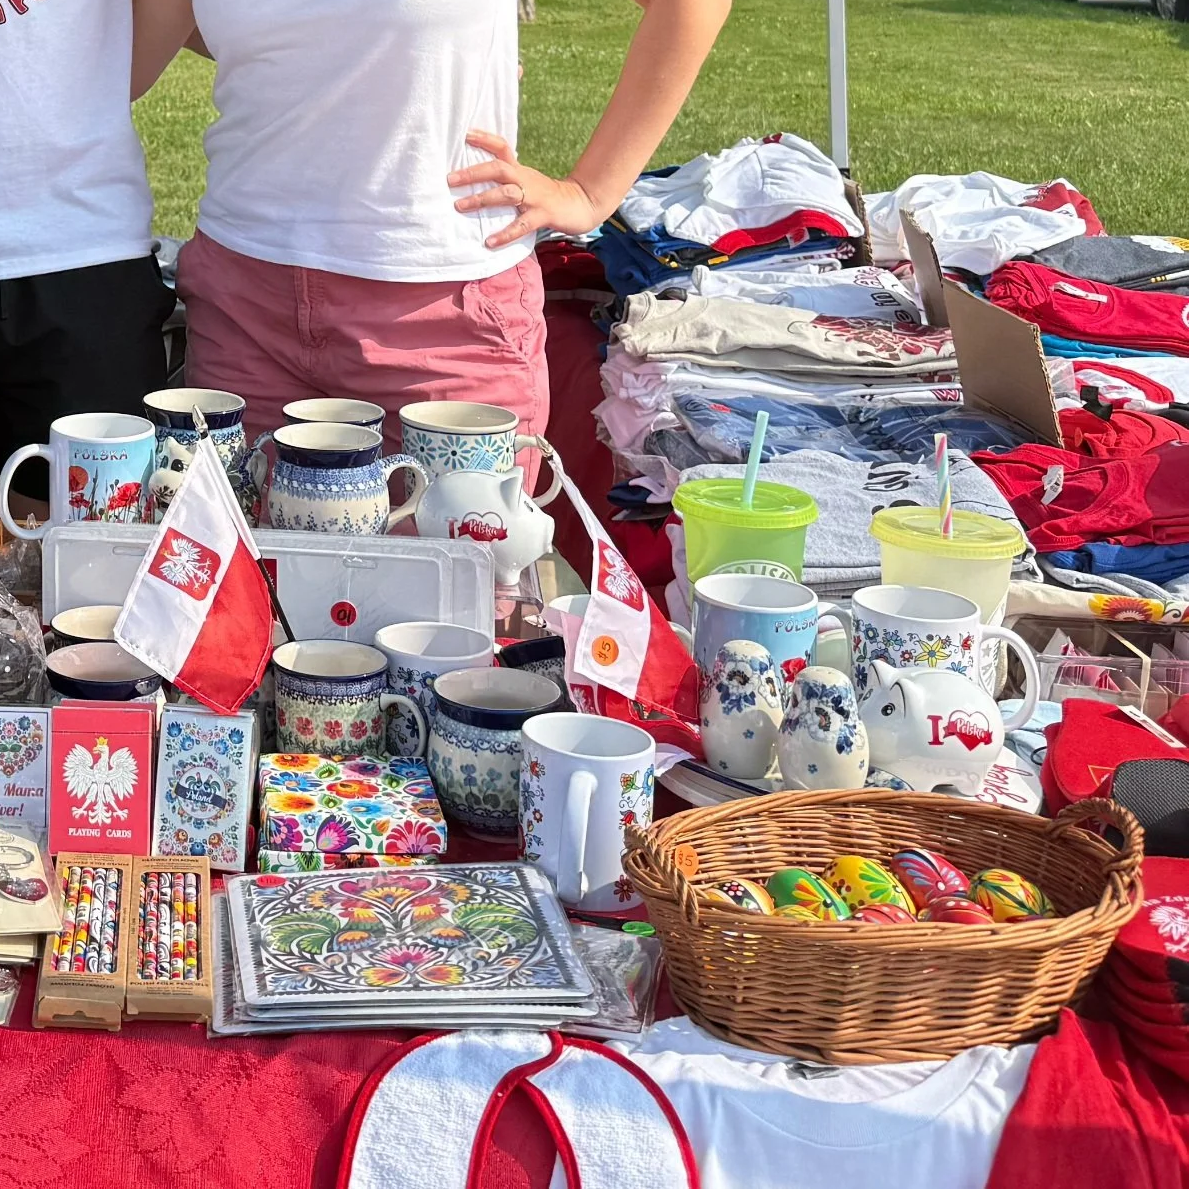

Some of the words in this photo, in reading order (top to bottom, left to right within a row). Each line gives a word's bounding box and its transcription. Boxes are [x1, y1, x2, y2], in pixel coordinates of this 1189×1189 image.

[74, 448, 129, 461] POLSKA
[927, 715, 944, 746] I
[954, 718, 986, 739] Polska
[2, 781, 45, 798] Mama
[68, 827, 101, 838] PLAYING
[106, 828, 132, 839] CARDS
[678, 850, 694, 867] $5
